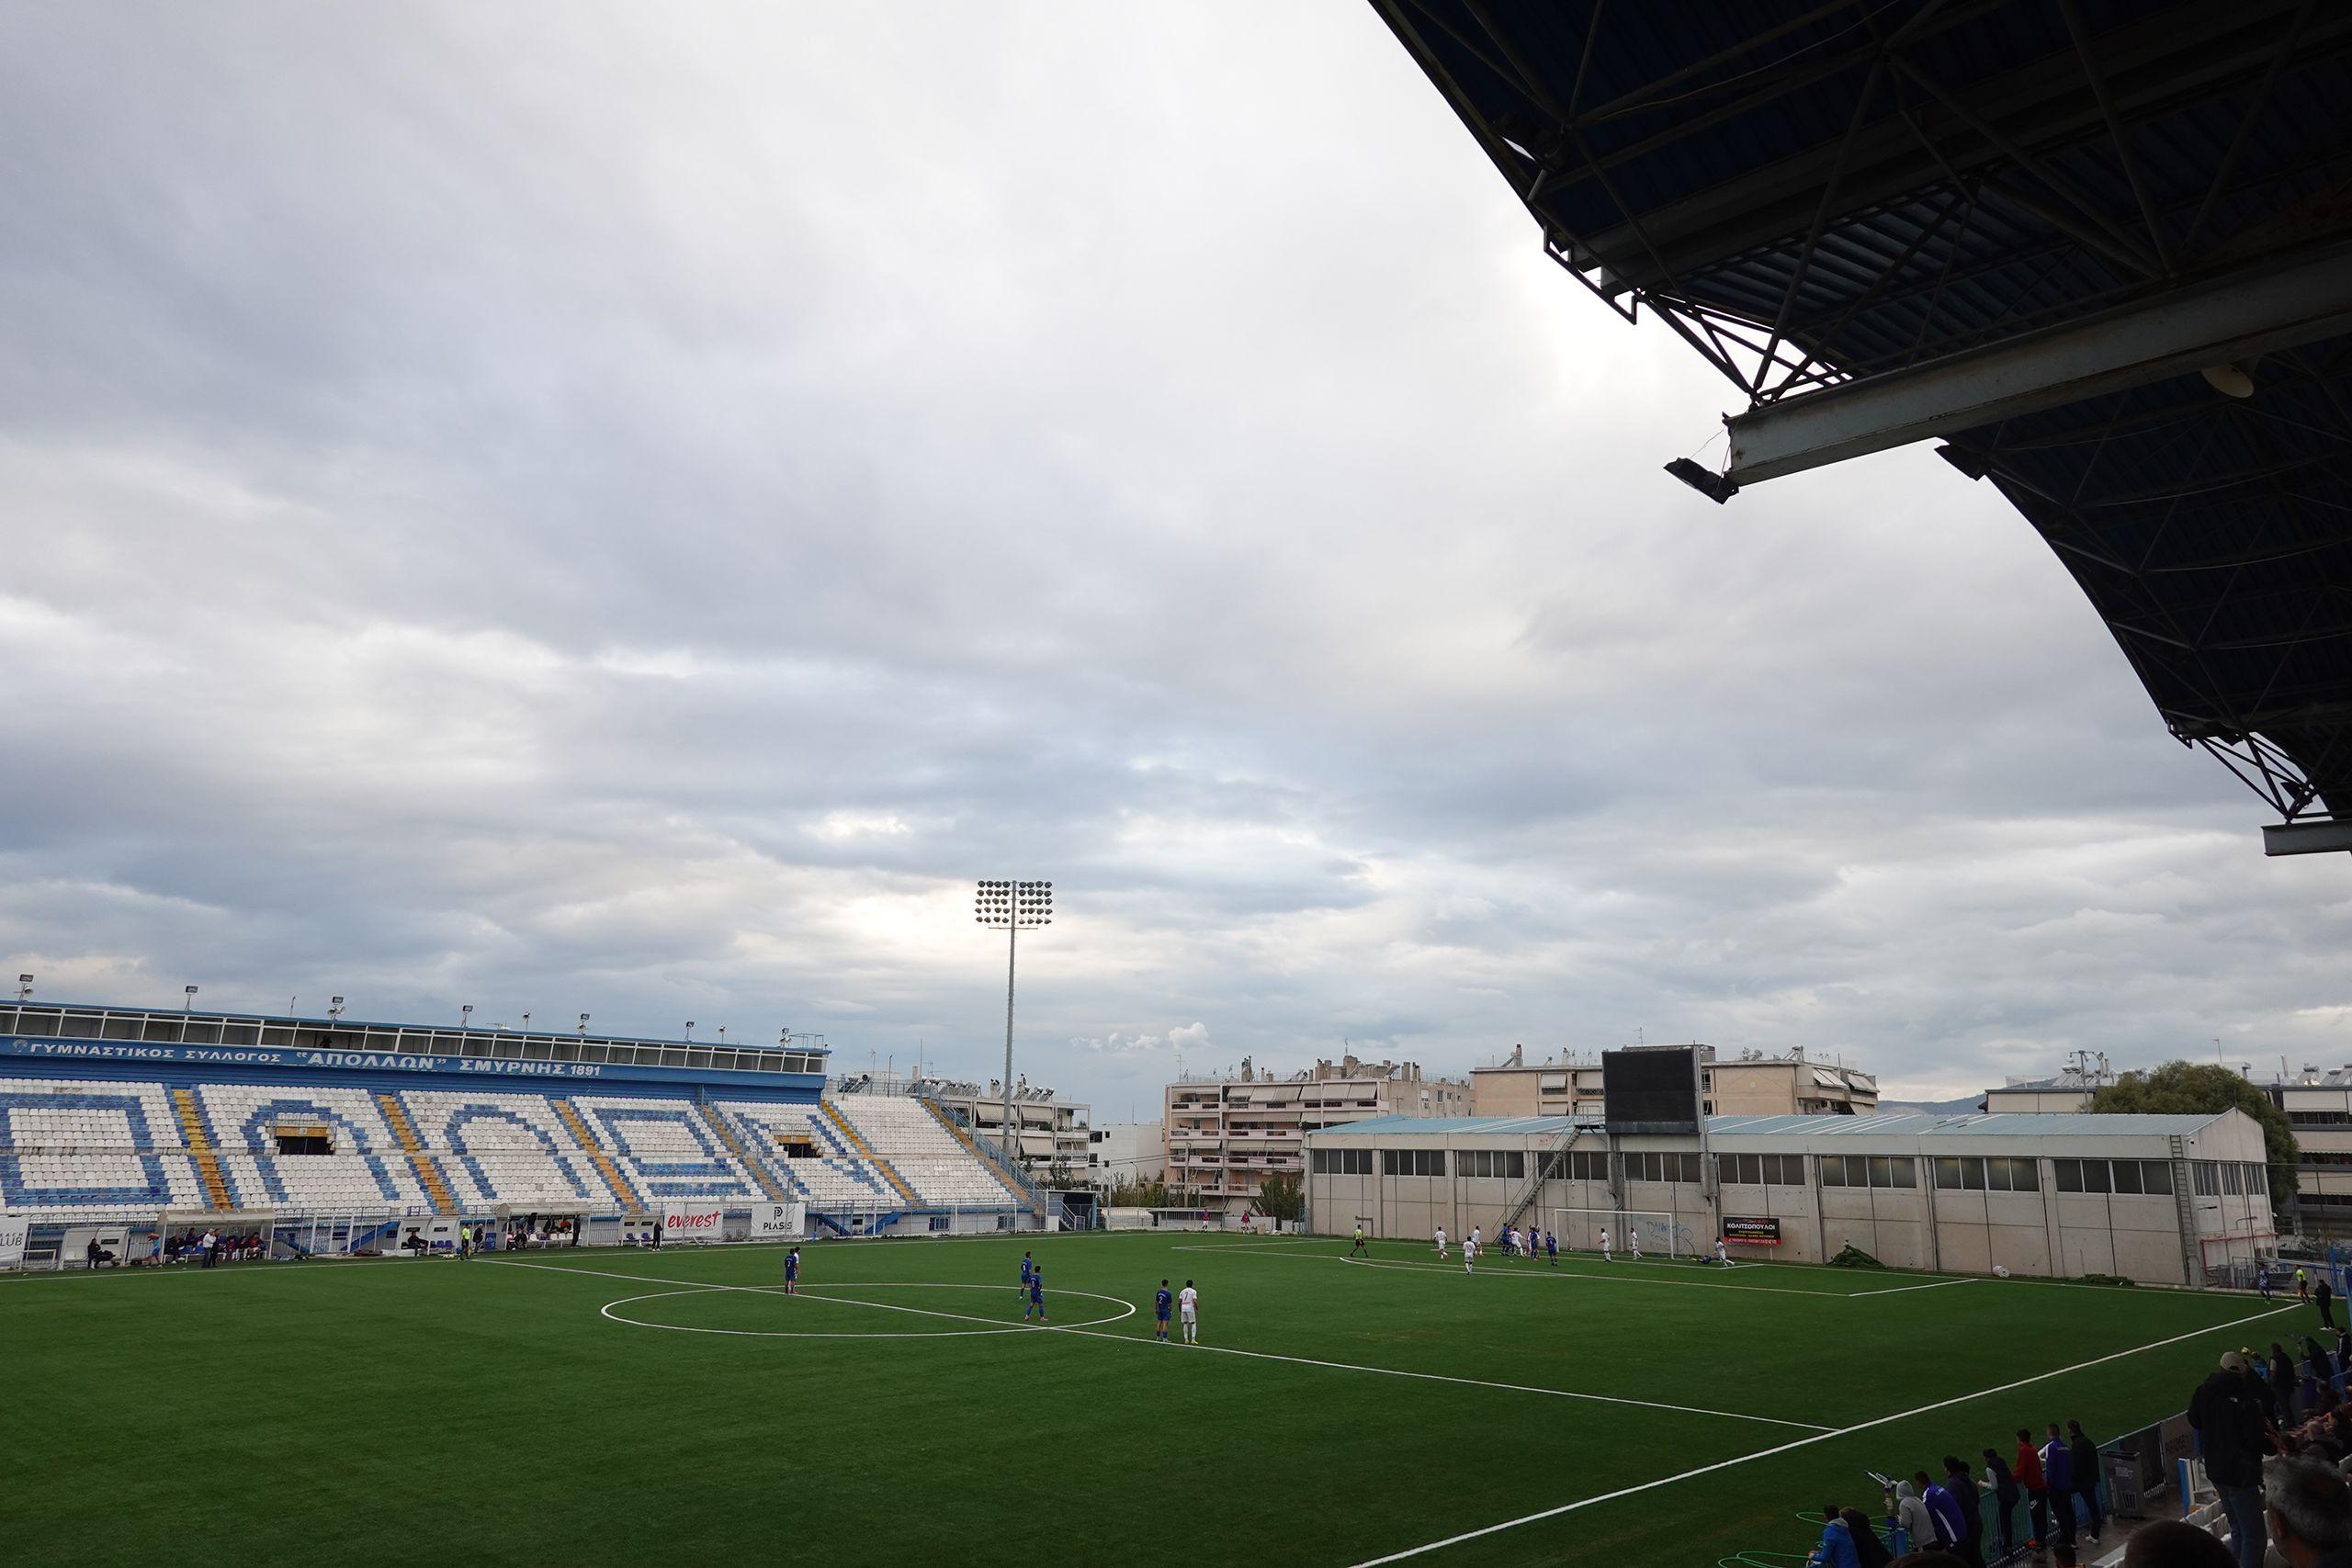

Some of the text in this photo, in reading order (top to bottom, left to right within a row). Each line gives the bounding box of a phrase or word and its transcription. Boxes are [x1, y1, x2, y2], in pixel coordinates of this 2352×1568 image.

[29, 1043, 175, 1058] ΓΥΜΝΑΣΤΙΚΟΣ
[185, 1050, 281, 1063] ΣΥΛΛΟΓΟΣ
[459, 1059, 565, 1075] ΣΜΥΡΝΗΣ
[571, 1065, 601, 1077] 1891
[668, 1211, 722, 1228] everest
[763, 1222, 793, 1231] PLASS
[1184, 1292, 1189, 1301] 7
